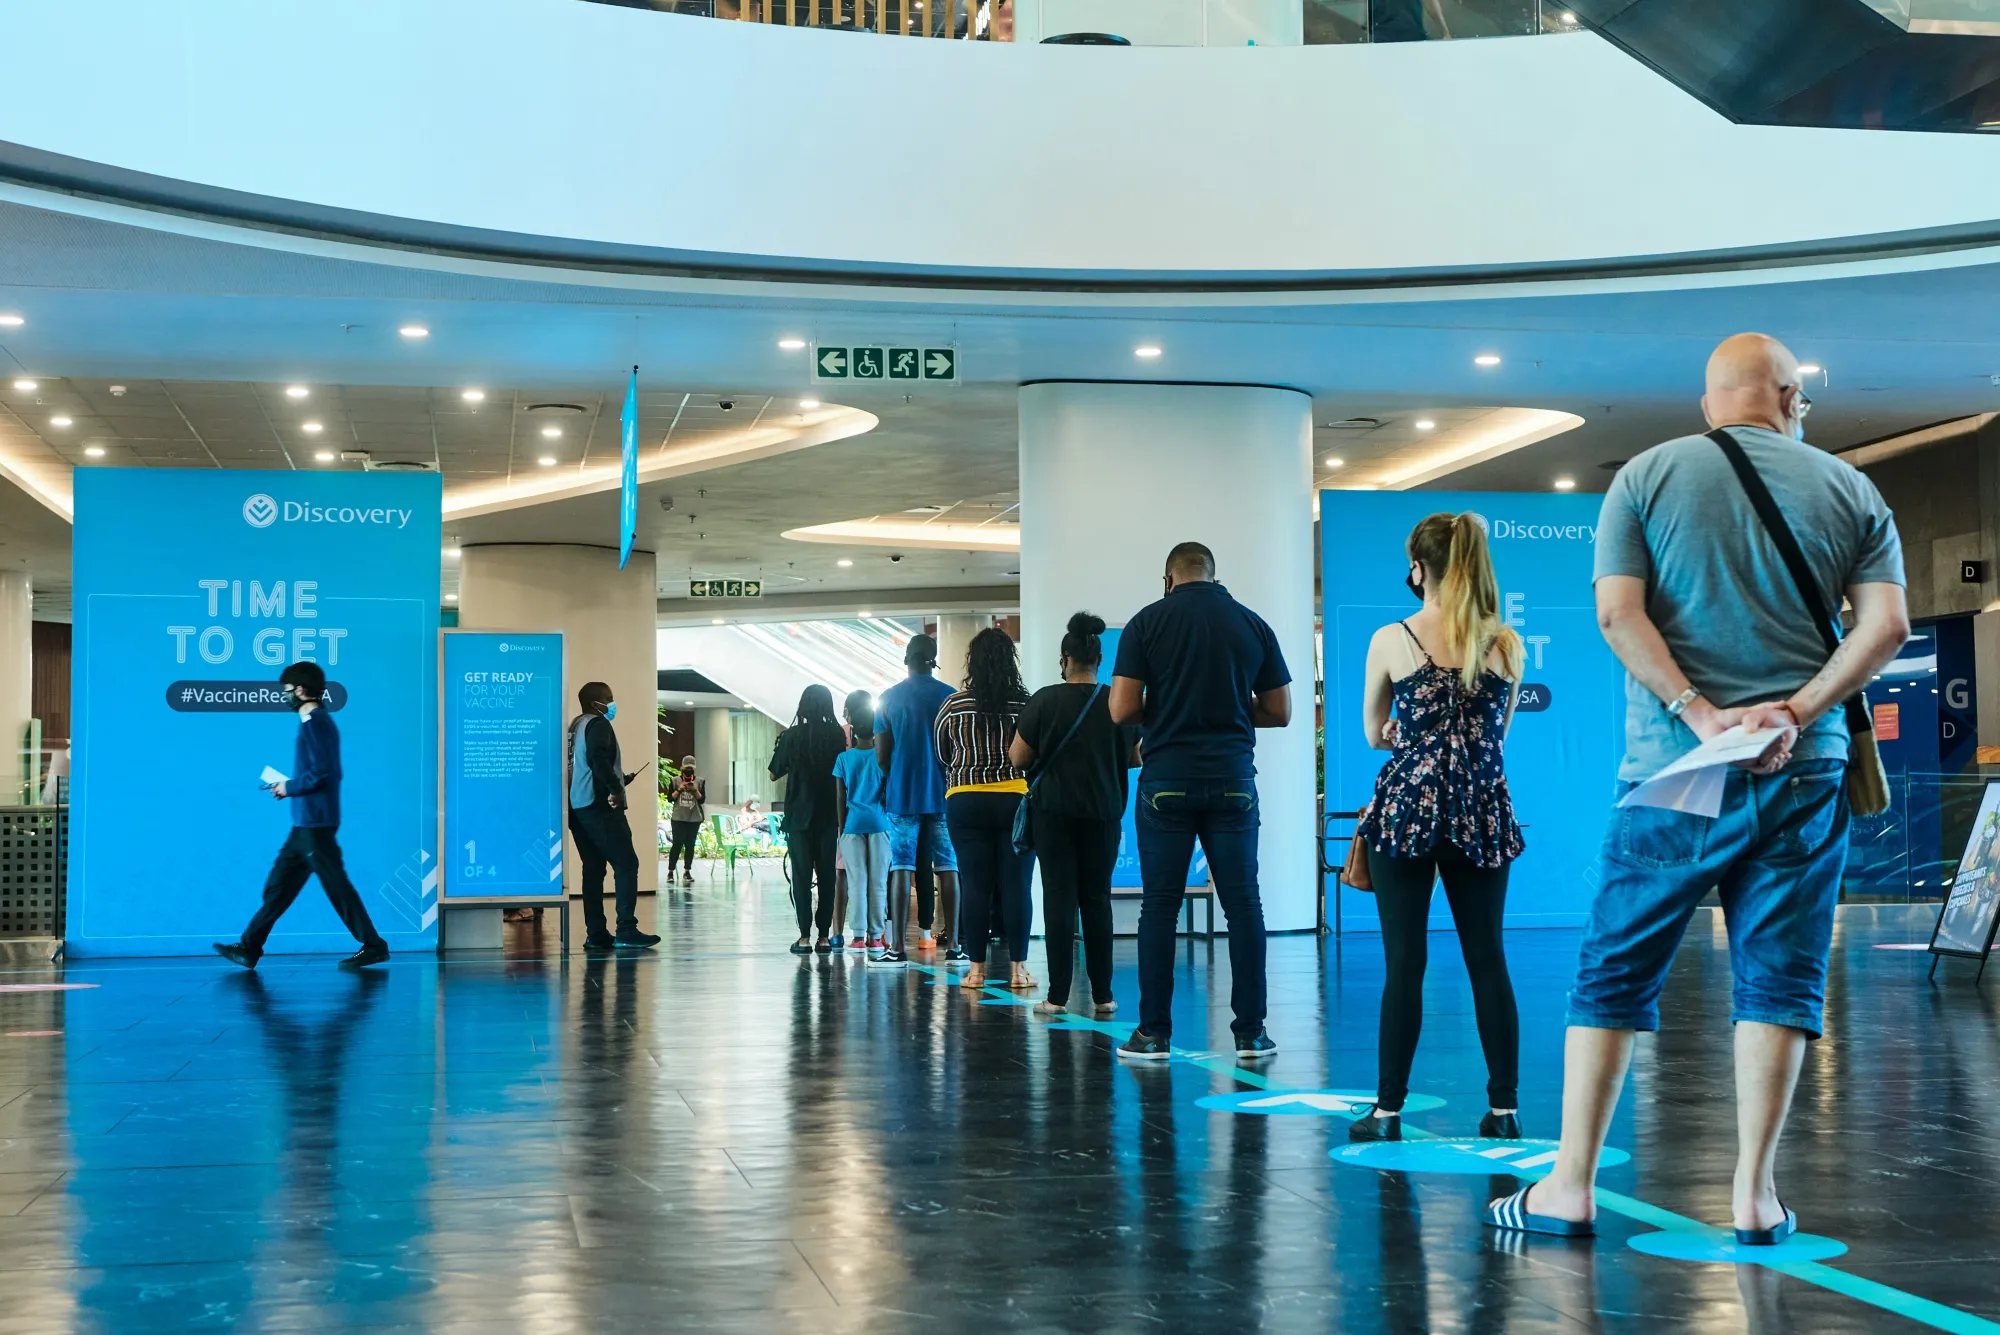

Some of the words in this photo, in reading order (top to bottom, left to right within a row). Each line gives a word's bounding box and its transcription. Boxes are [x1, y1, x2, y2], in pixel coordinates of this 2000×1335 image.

[283, 500, 412, 528] Discovery
[1494, 519, 1597, 544] Discovery
[1965, 566, 1975, 578] D
[199, 579, 318, 618] TIME
[167, 625, 234, 664] TO
[253, 627, 348, 665] GET
[509, 643, 546, 652] Discovery
[464, 672, 489, 683] GET
[491, 672, 534, 683] READY
[464, 684, 489, 696] FOR
[491, 684, 525, 696] YOUR
[1945, 678, 1969, 709] G
[464, 697, 515, 709] VACCINE
[1943, 722, 1956, 738] D
[464, 839, 476, 864] 1
[1116, 857, 1134, 868] OF
[464, 866, 484, 878] OF
[488, 866, 497, 877] 4
[1948, 894, 1971, 909] CUPCAKES
